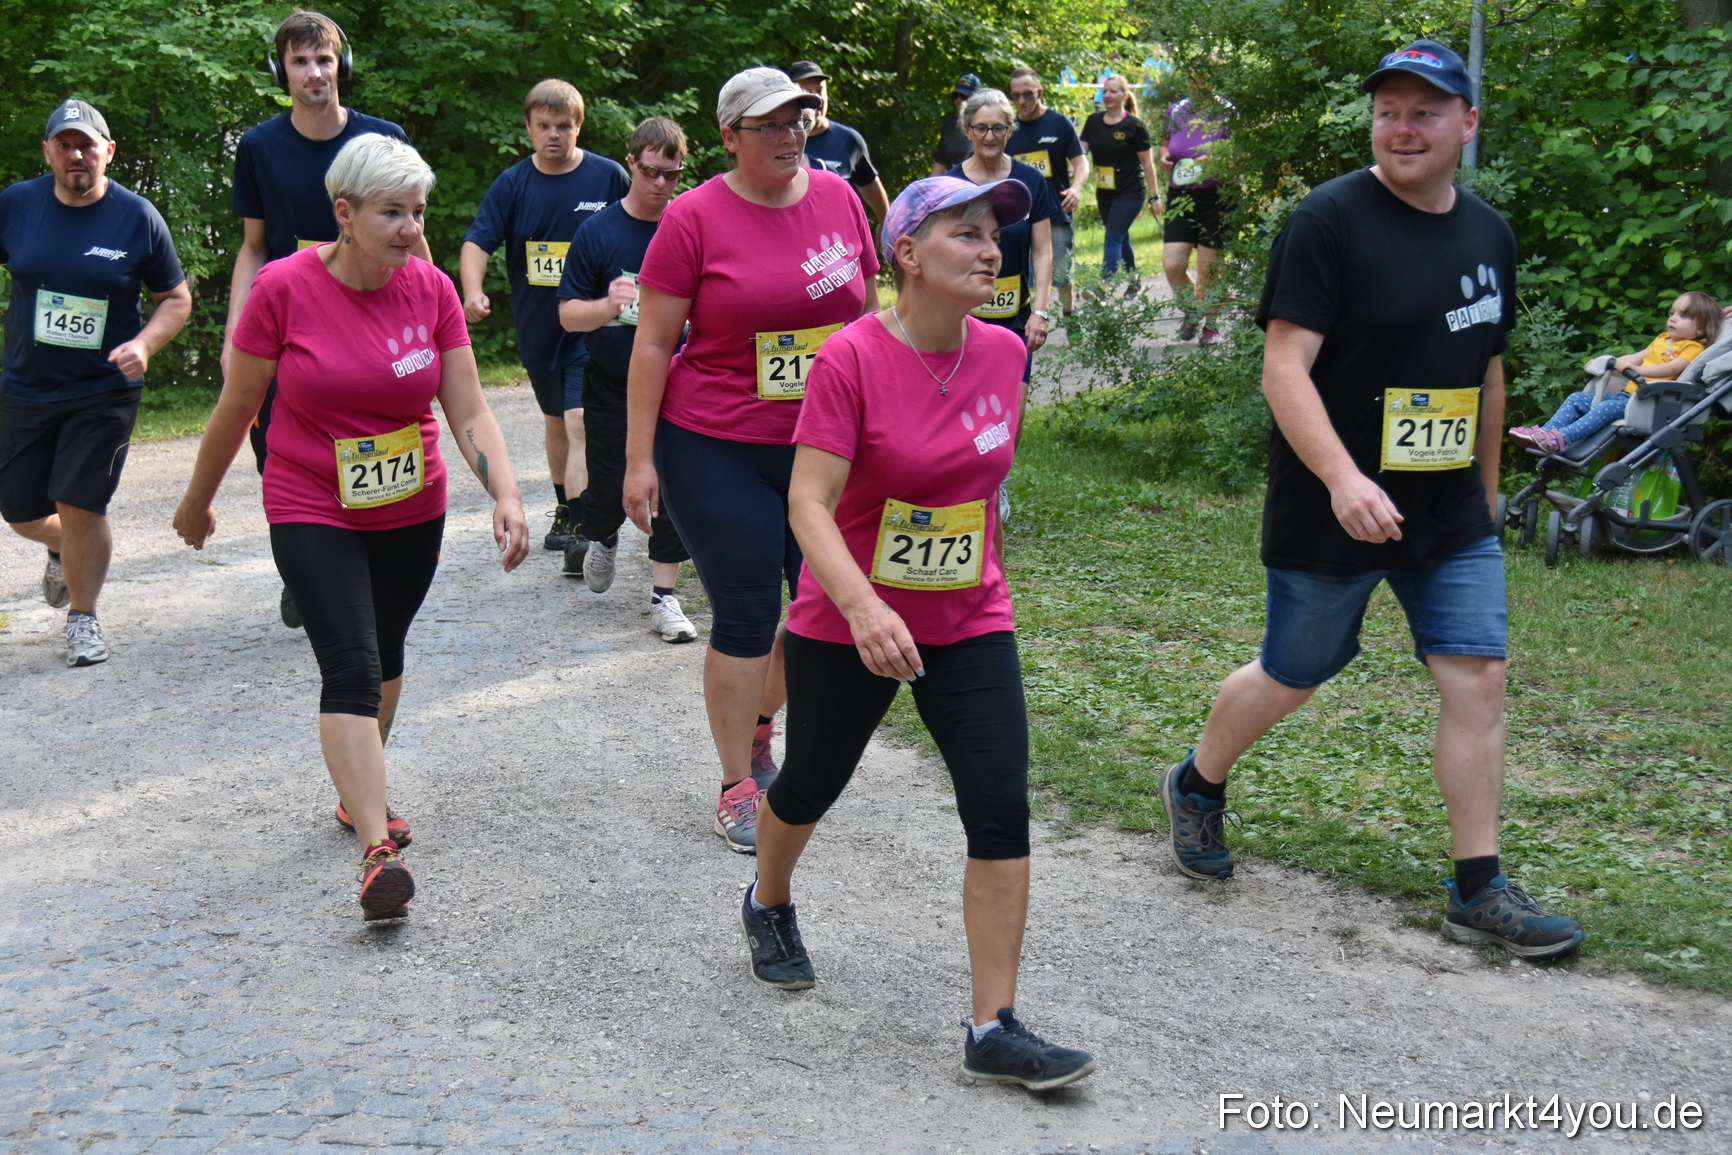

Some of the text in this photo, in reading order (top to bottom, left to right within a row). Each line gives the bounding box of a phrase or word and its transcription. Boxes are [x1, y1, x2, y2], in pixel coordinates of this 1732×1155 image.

[802, 242, 847, 275] TANTE
[44, 311, 96, 334] 1456
[771, 342, 808, 352] firmenlauf
[779, 381, 804, 389] Vogele
[974, 423, 1009, 454] CARO
[1396, 418, 1467, 447] 2176
[1408, 449, 1435, 457] Vogele
[351, 451, 416, 490] 2174
[352, 476, 418, 497] Scherer-Fürst Conny
[888, 534, 972, 567] 2173
[906, 566, 958, 576] Schaaf Caro
